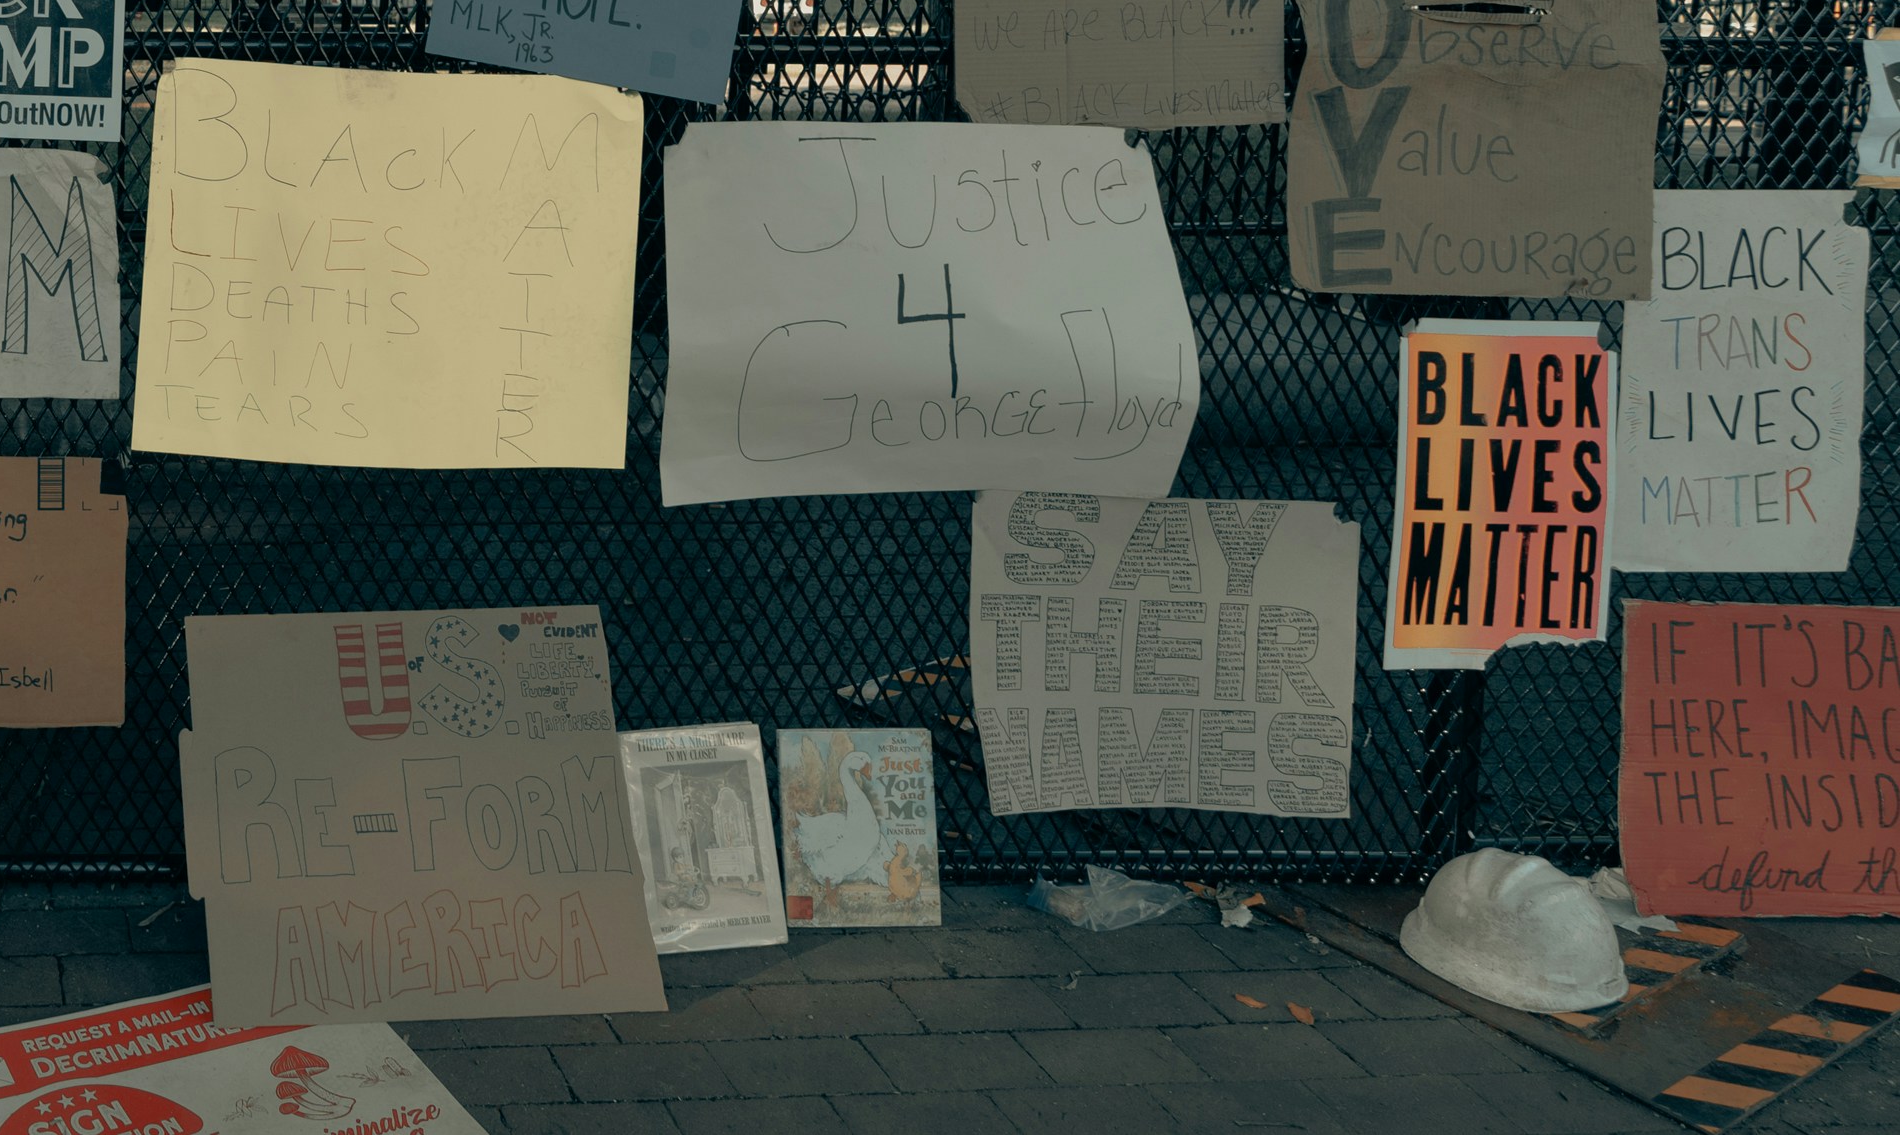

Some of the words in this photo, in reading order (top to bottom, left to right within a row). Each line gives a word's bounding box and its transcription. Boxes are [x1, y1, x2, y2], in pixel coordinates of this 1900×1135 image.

[515, 43, 554, 63] 1963
[174, 68, 475, 192] BLACK
[170, 188, 430, 276] LIVES
[1661, 226, 1833, 295] BLACK
[166, 319, 352, 389] PAIN
[898, 264, 965, 399] 4
[1660, 312, 1812, 370] TRANS
[1417, 351, 1601, 427] BLACK
[1648, 385, 1821, 451] LIVES
[1414, 437, 1601, 513] LIVES
[1641, 467, 1818, 527] MATTER
[1004, 491, 1288, 596] SAY
[1402, 522, 1598, 629] MATTER
[544, 624, 598, 638] EVIDENT
[980, 594, 1335, 707] THEIR
[1652, 621, 1694, 685] IF
[879, 757, 923, 773] Just
[976, 707, 1348, 813] NAMES
[885, 800, 928, 820] Me
[1644, 769, 1734, 825] THE
[271, 889, 607, 1016] AMERICA
[21, 1023, 114, 1053] REQUEST
